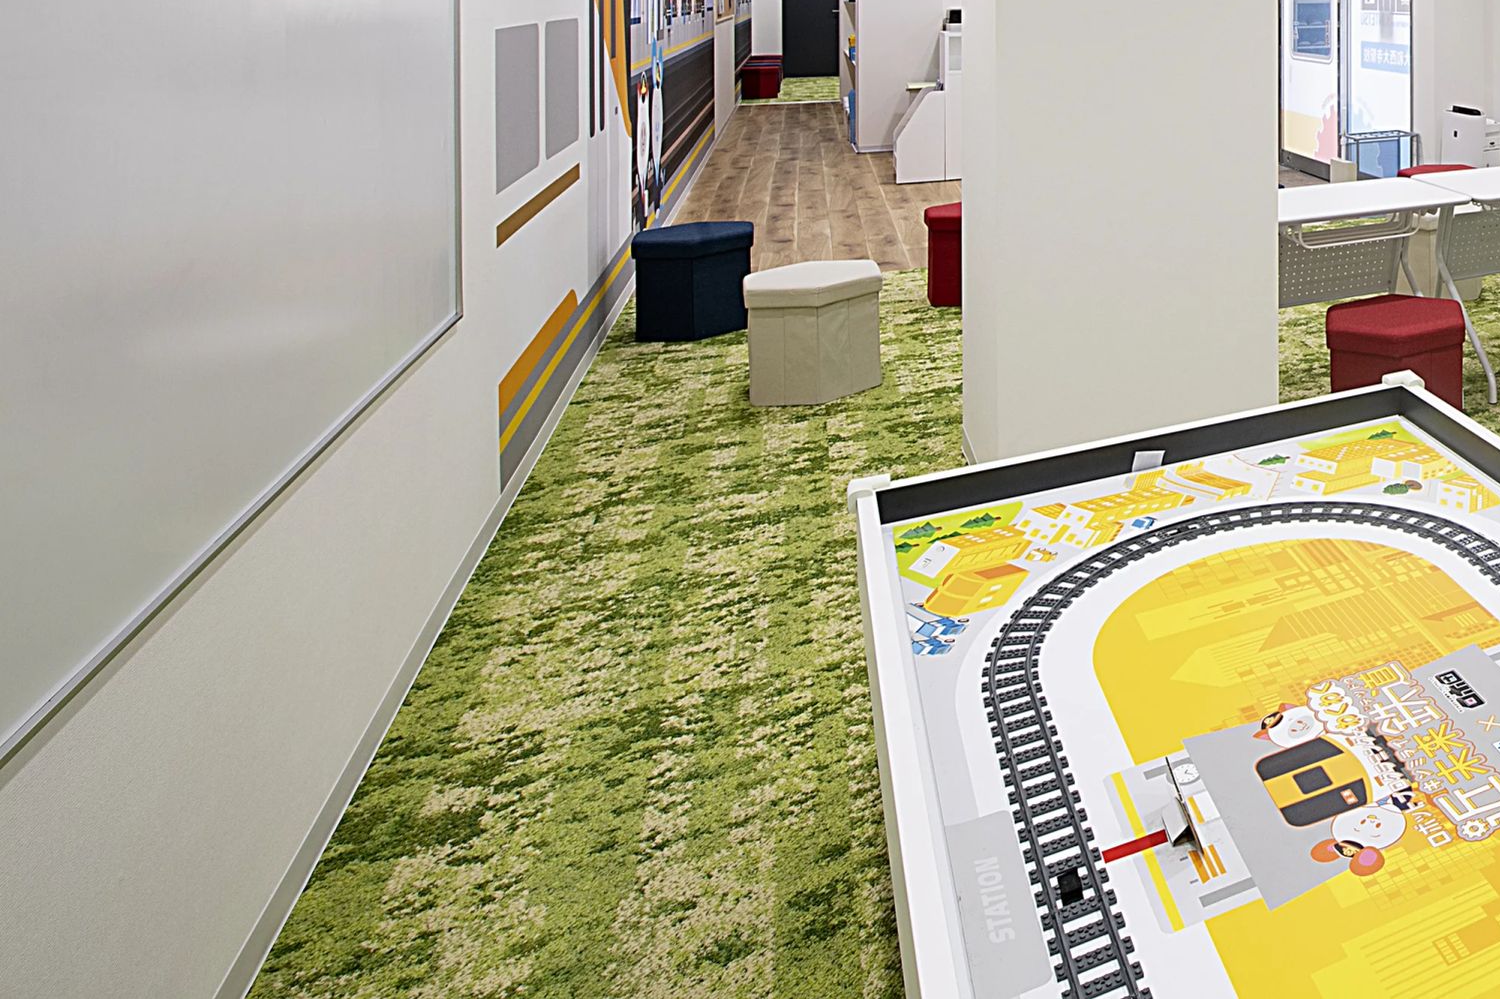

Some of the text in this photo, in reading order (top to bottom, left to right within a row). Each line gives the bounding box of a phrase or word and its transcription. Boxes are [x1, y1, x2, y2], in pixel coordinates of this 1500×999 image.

[1309, 681, 1361, 729] わくわく
[974, 856, 1016, 943] STATION
